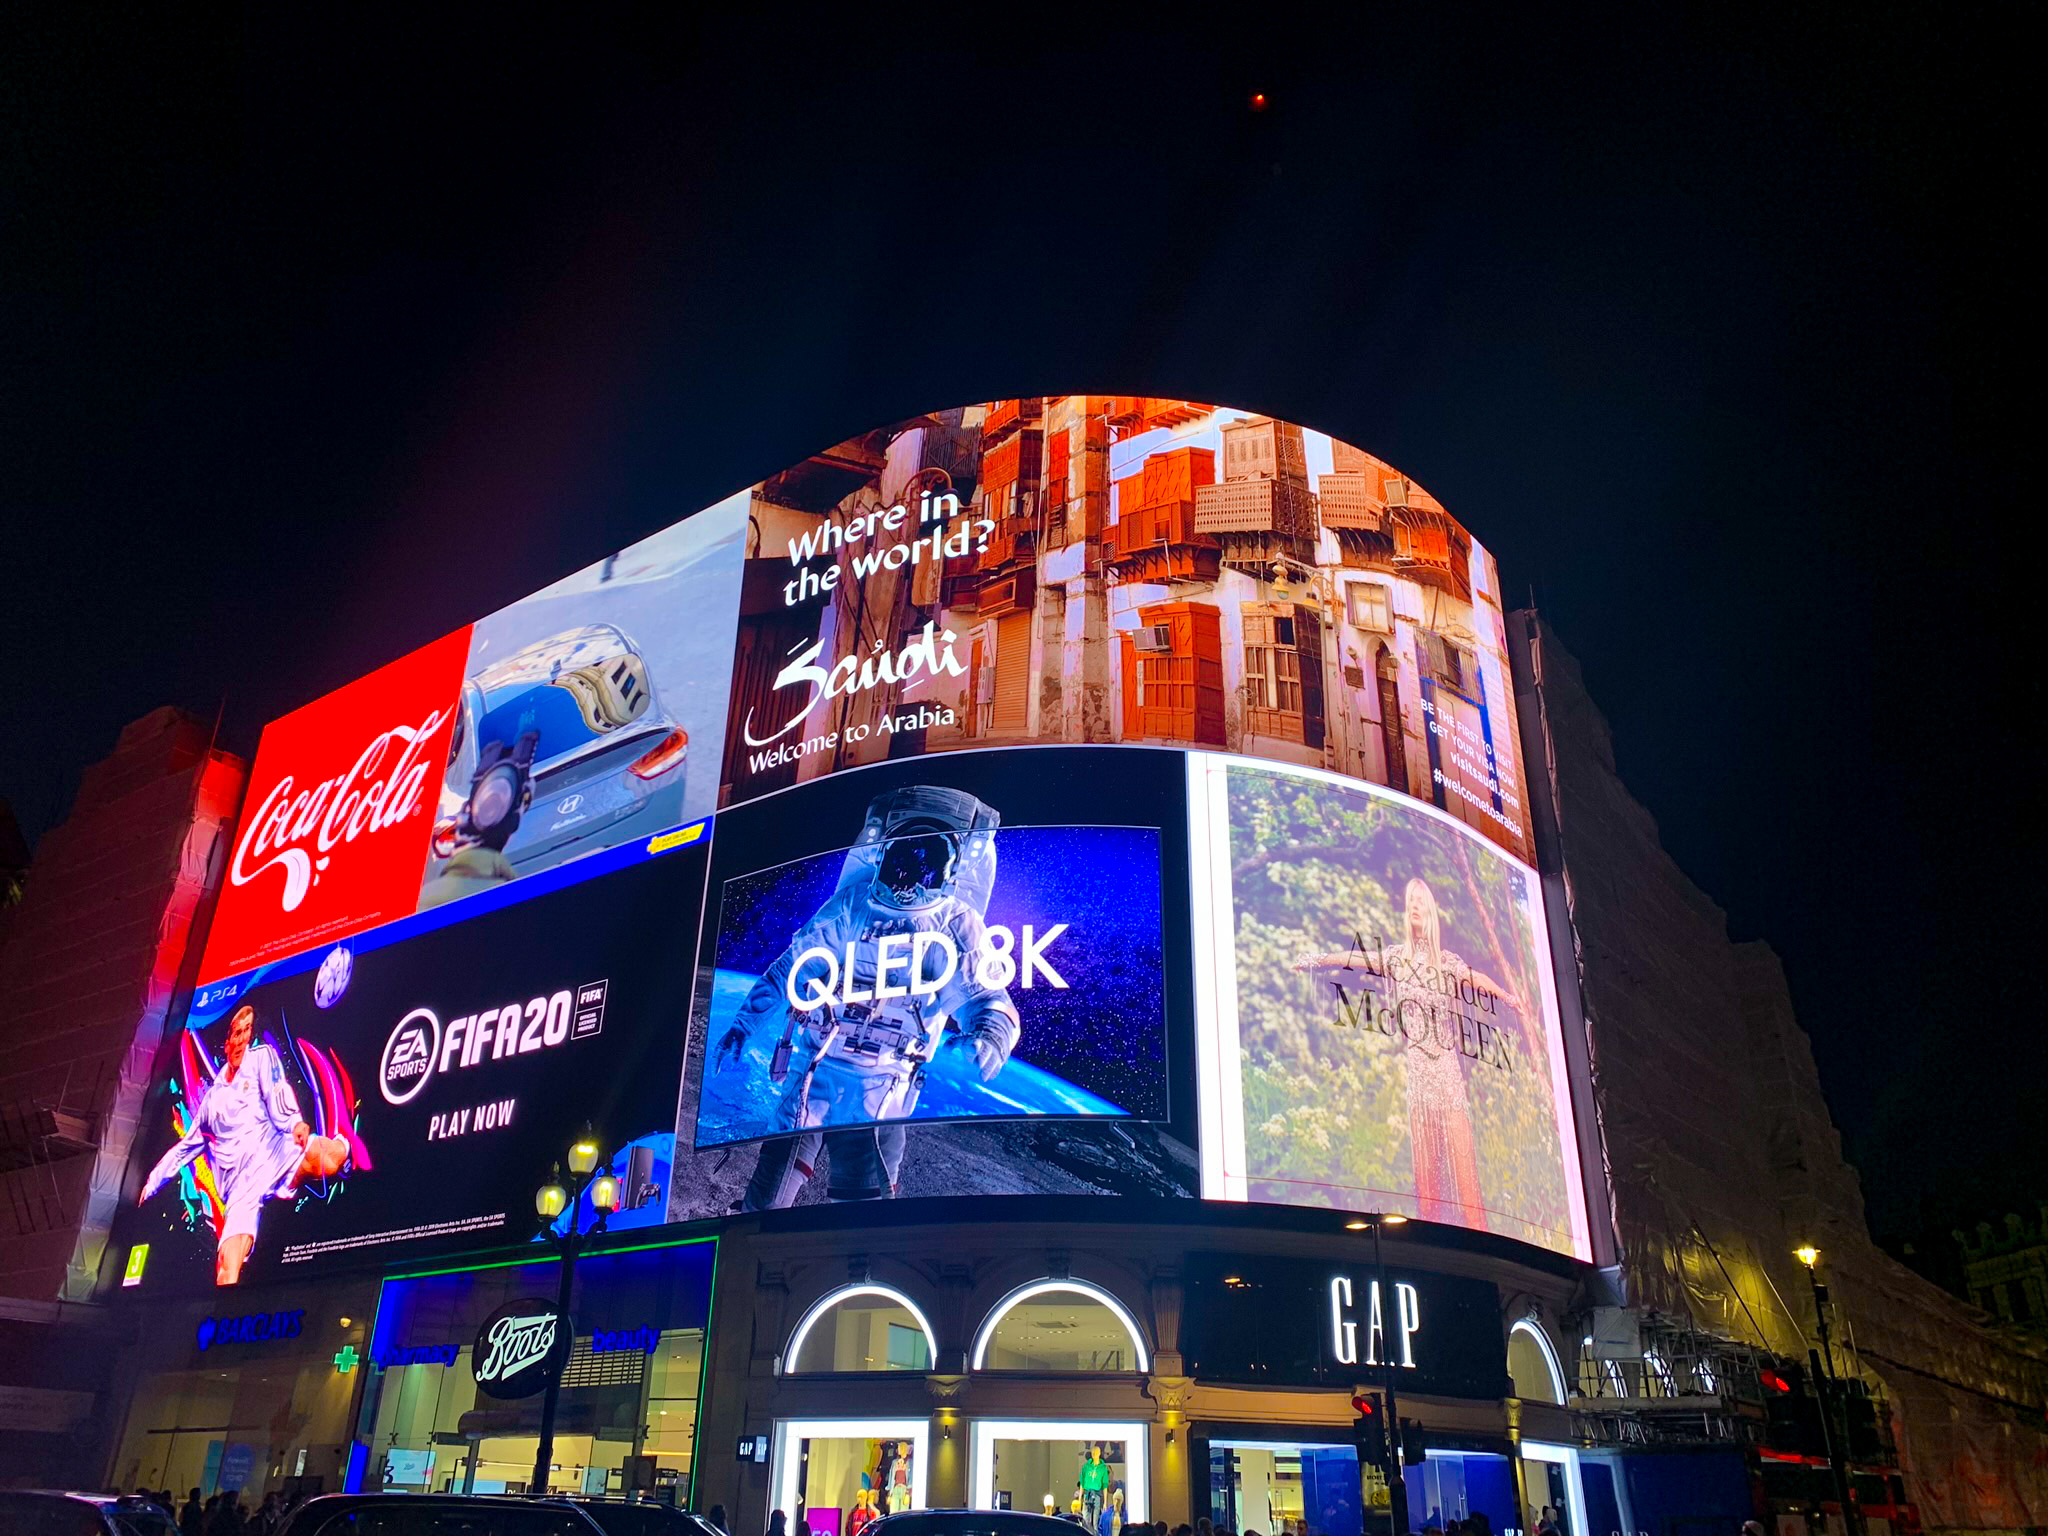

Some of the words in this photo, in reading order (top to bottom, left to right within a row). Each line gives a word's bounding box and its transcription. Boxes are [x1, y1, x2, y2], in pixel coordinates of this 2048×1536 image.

[787, 504, 906, 567] Where
[920, 490, 959, 522] in
[783, 565, 841, 607] the
[851, 519, 996, 580] world?
[744, 620, 968, 747] Saudi
[749, 733, 838, 775] Welcome
[845, 725, 870, 744] to
[877, 705, 954, 737] Arabia
[1420, 698, 1435, 716] BE
[1436, 706, 1455, 728] THE
[1457, 720, 1480, 745] FIRST
[1481, 738, 1492, 755] TO
[1429, 720, 1449, 740] GET
[1451, 733, 1475, 759] YOUR
[1475, 751, 1496, 775] VISA
[231, 703, 455, 912] Coca-Cola
[1433, 767, 1523, 839] #welcometoarabia
[1450, 751, 1520, 810] visitsaudi.com
[210, 984, 238, 1003] PS4
[580, 988, 603, 1004] FIFA
[787, 931, 958, 1012] QLED
[975, 923, 1070, 990] 8K
[1343, 932, 1498, 1016] Alexander
[390, 1028, 428, 1065] EA
[1330, 981, 1512, 1074] McQUEEN
[387, 1058, 429, 1081] SPORTS
[428, 1108, 470, 1141] PLAY
[473, 1099, 515, 1132] NOW
[216, 1309, 305, 1344] BARCLAYS
[476, 1312, 558, 1381] Boots
[592, 1324, 660, 1354] beauty
[1331, 1276, 1420, 1368] GAP
[739, 1442, 754, 1456] GAP
